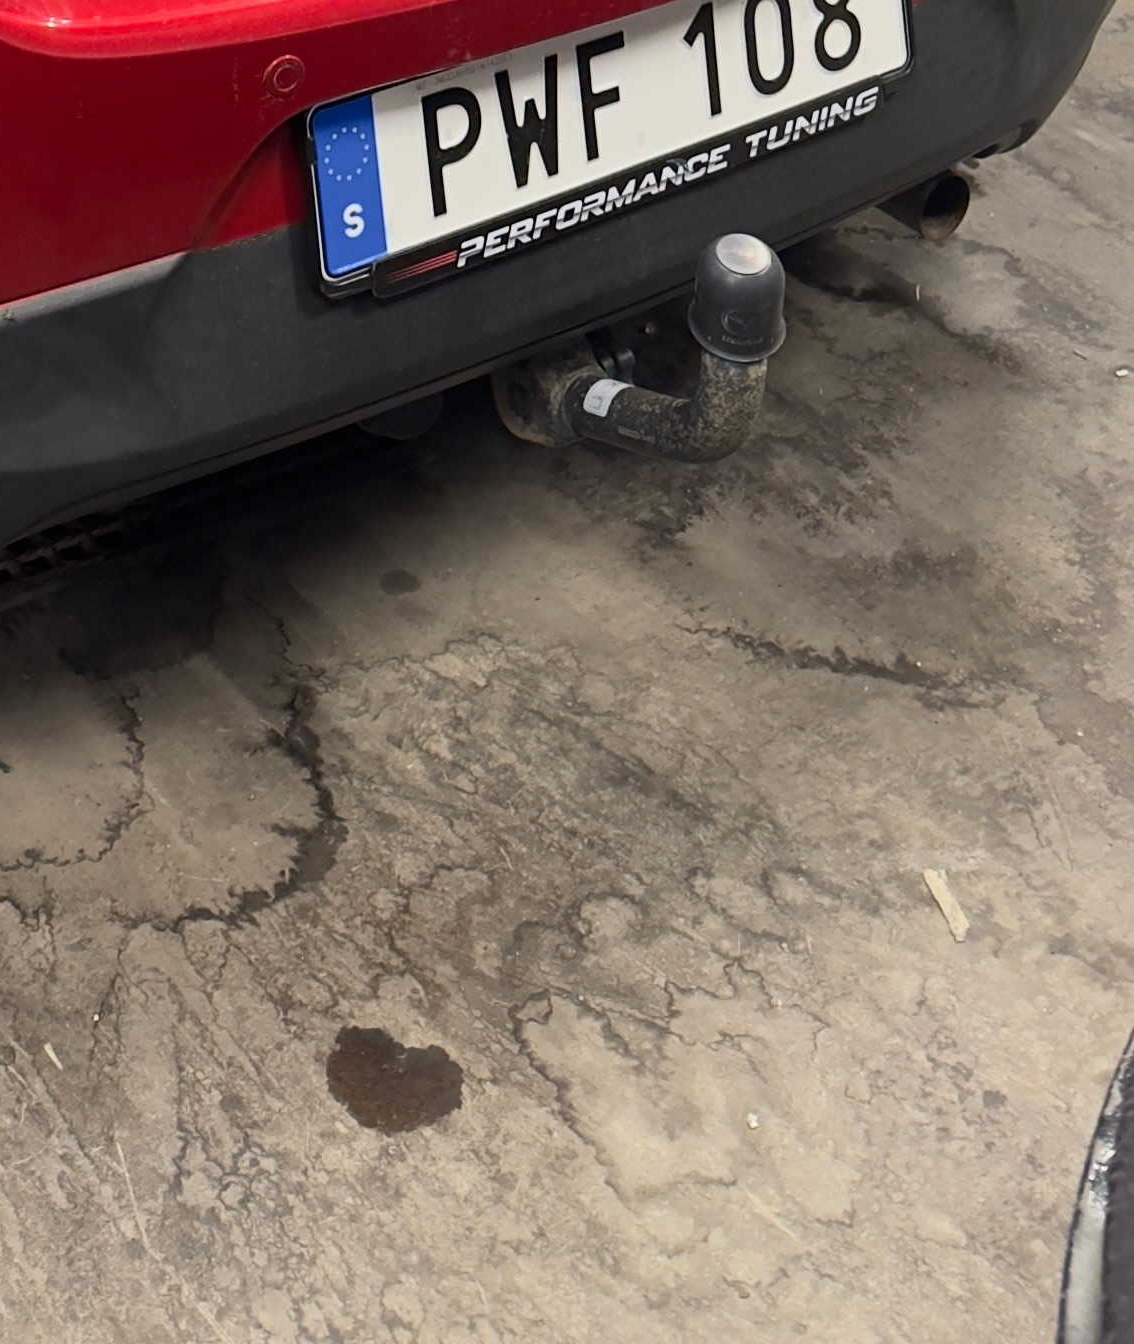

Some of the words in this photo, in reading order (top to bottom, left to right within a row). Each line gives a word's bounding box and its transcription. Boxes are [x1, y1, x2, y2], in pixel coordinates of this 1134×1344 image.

[421, 30, 626, 217] PWF
[455, 143, 731, 268] PERFORMANCE
[744, 86, 880, 158] TUNING
[342, 203, 365, 238] S
